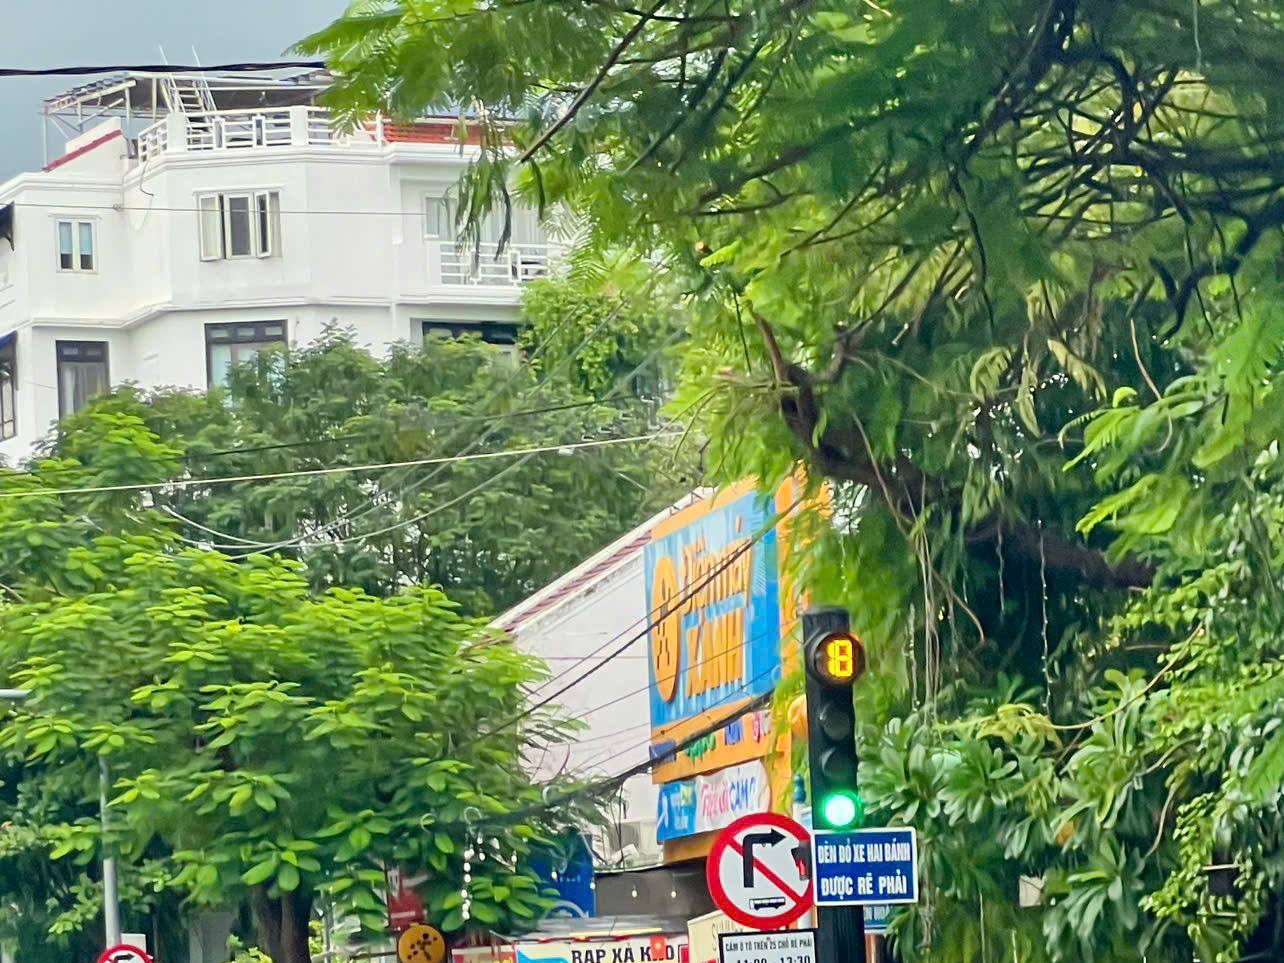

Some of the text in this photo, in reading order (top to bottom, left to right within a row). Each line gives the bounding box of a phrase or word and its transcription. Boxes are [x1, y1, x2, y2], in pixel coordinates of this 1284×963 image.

[686, 608, 745, 698] XANH
[818, 838, 911, 863] ĐÈN ĐỎ XE HAI BÁNH
[821, 868, 907, 900] ĐƯỢC RẼ PHẢI
[641, 944, 675, 962] KO
